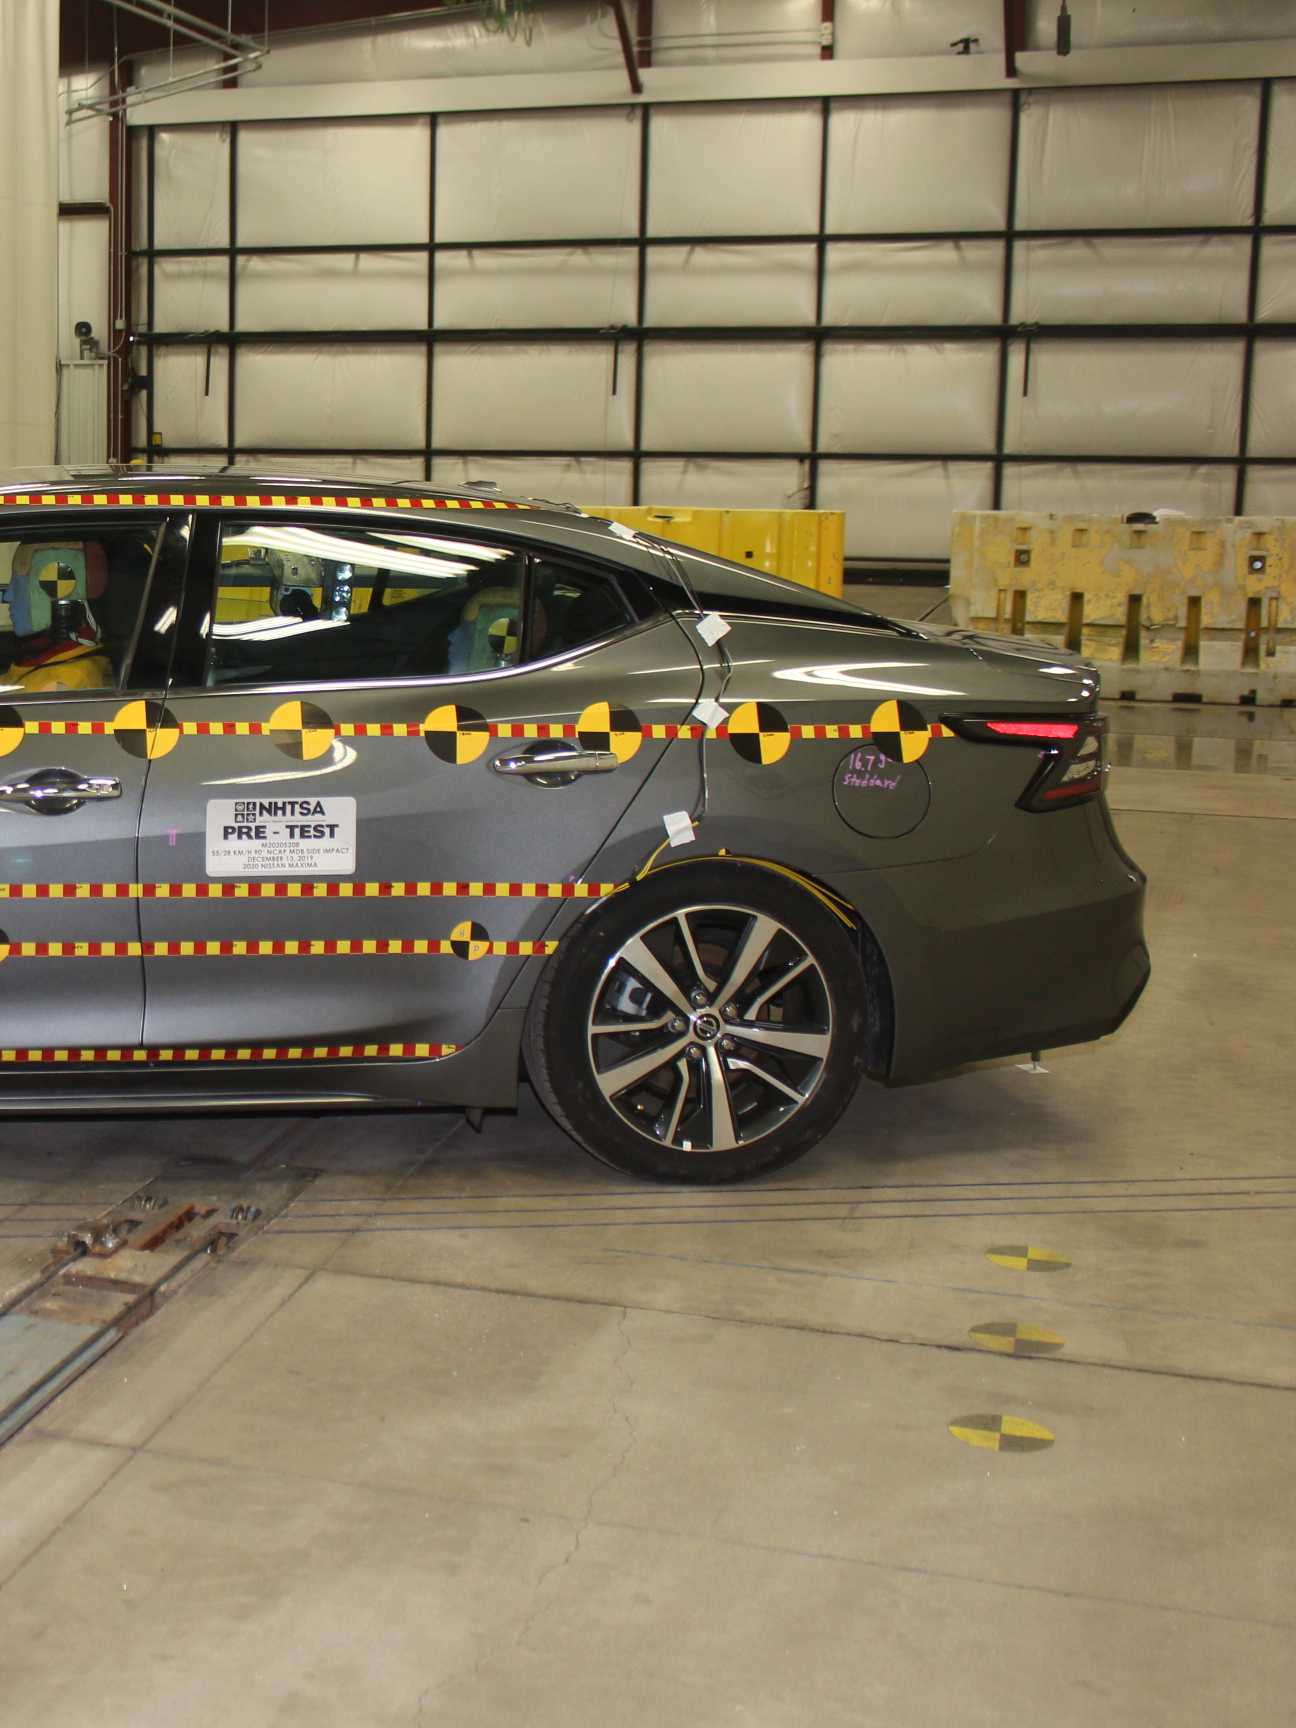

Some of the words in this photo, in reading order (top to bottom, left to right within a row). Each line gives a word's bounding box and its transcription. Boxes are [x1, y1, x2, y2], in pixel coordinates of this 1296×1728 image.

[849, 752, 876, 771] 16.7
[259, 800, 326, 817] NHTSA
[223, 825, 267, 840] PRE
[285, 823, 339, 839] TEST
